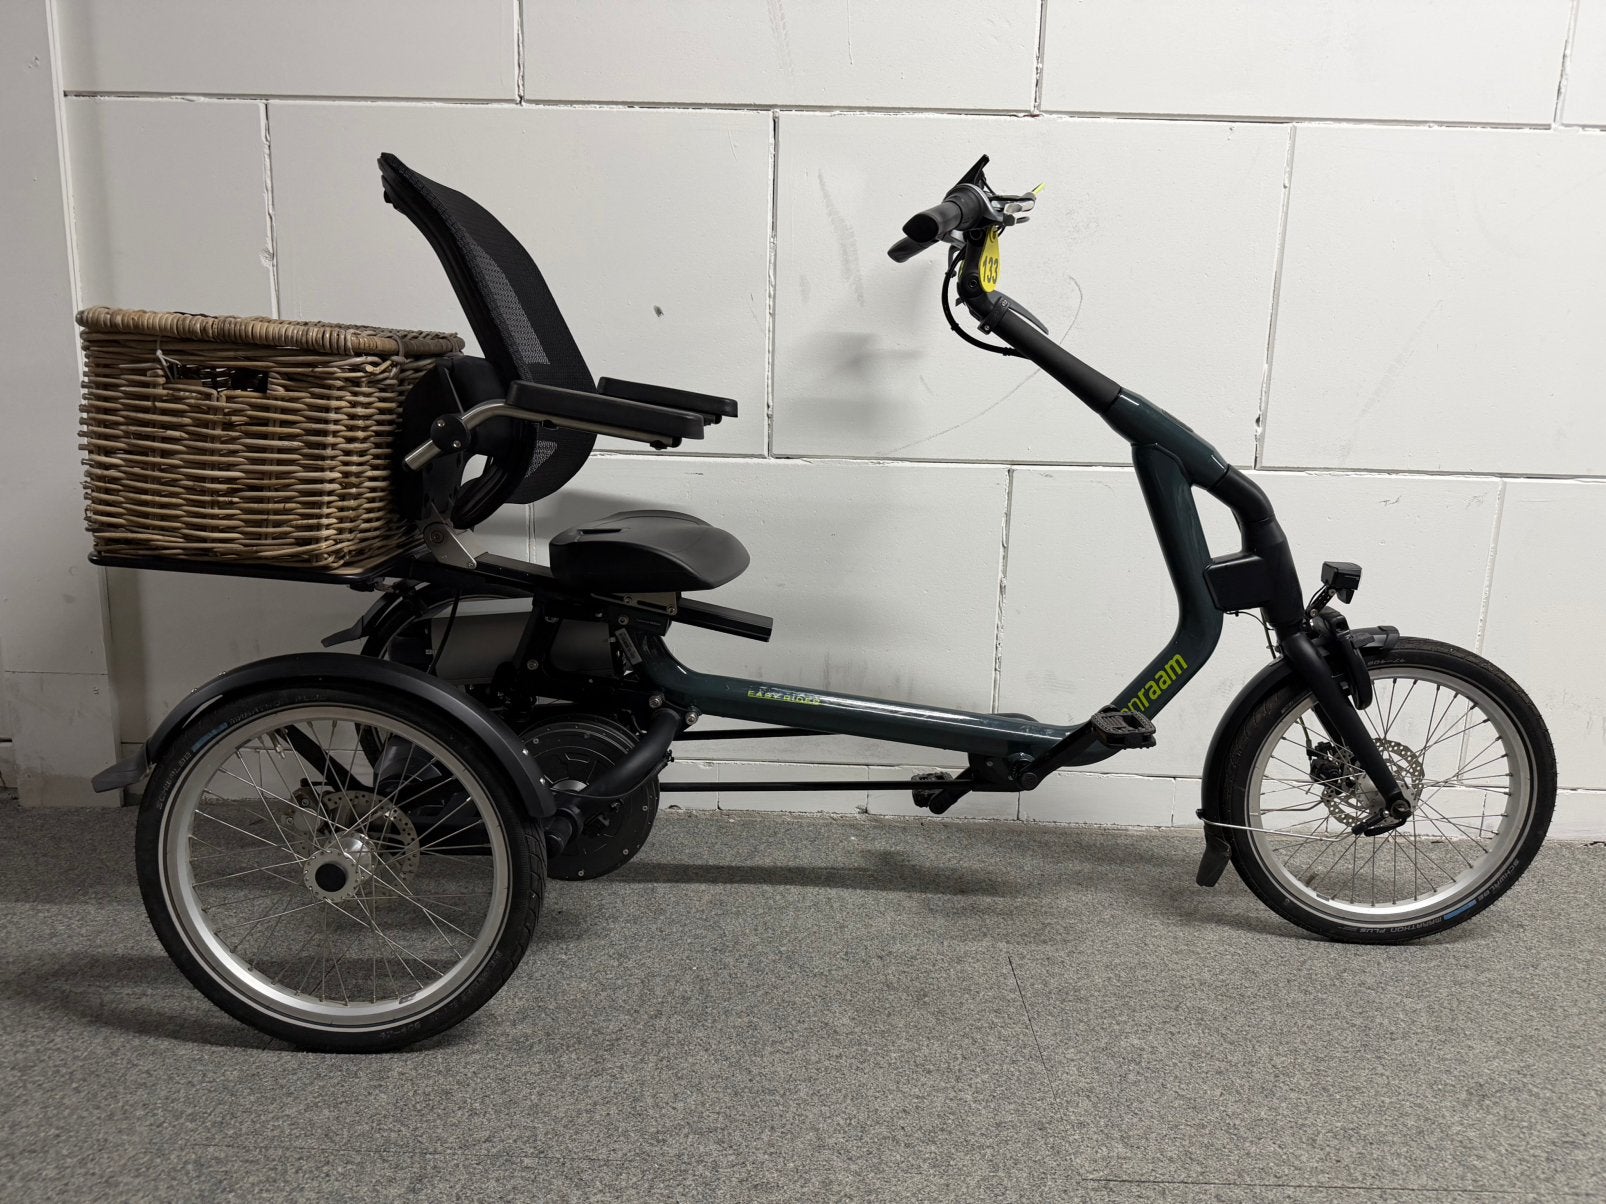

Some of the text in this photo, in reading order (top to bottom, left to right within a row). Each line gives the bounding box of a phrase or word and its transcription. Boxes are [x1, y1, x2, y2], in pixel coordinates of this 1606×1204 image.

[983, 255, 999, 284] 133
[747, 690, 821, 705] EASY RIDER
[1120, 653, 1188, 714] nraam
[1477, 859, 1520, 901] SCHWALBE
[1391, 916, 1442, 933] MARATHON
